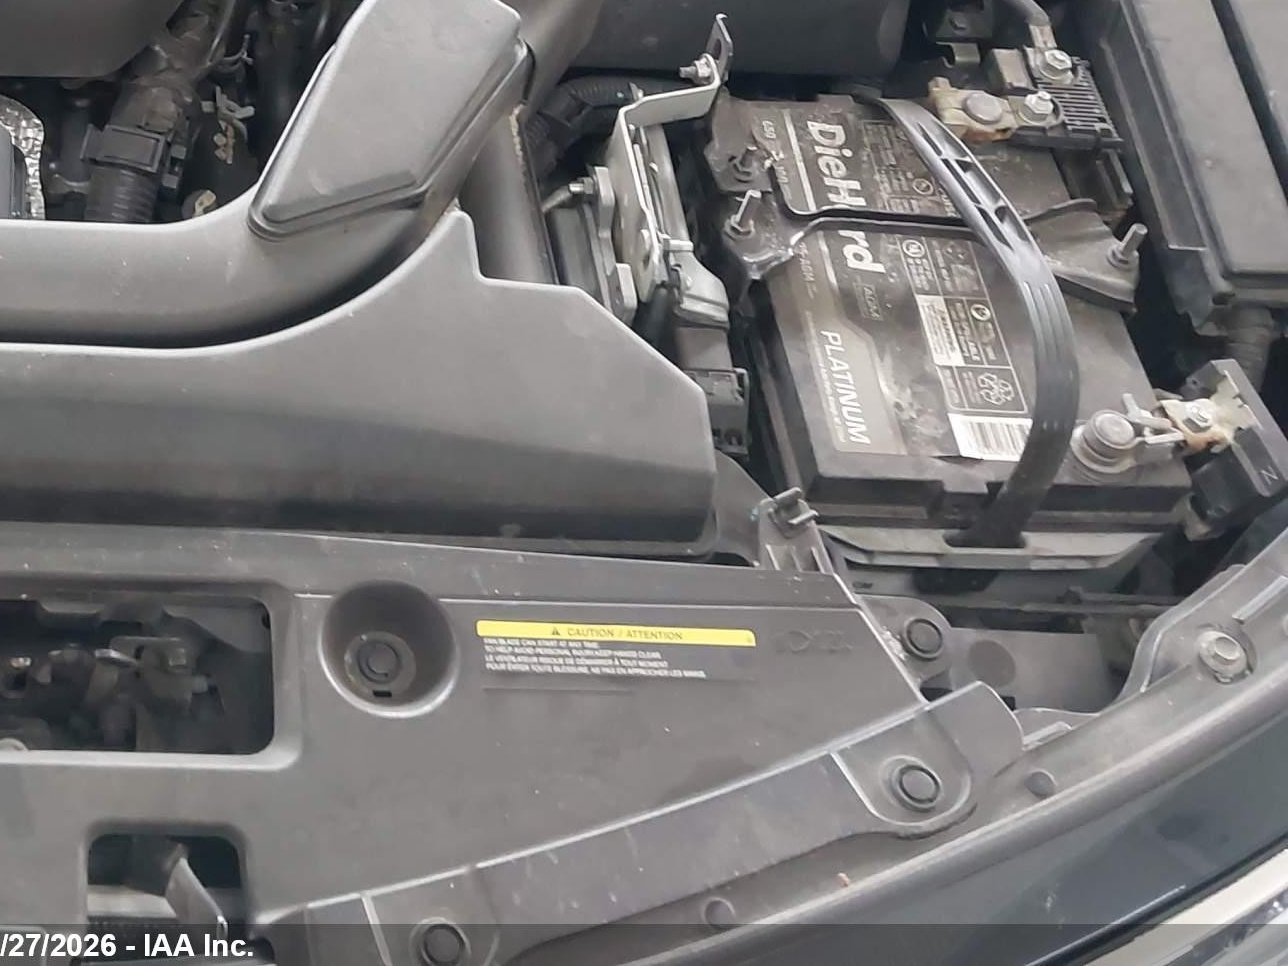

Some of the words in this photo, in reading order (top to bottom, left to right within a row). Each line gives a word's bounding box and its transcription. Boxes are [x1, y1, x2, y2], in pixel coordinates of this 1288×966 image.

[806, 120, 886, 274] DieHrd
[820, 330, 871, 445] PLATINUM
[567, 627, 614, 637] CAUTION
[626, 629, 683, 640] ATTENTION
